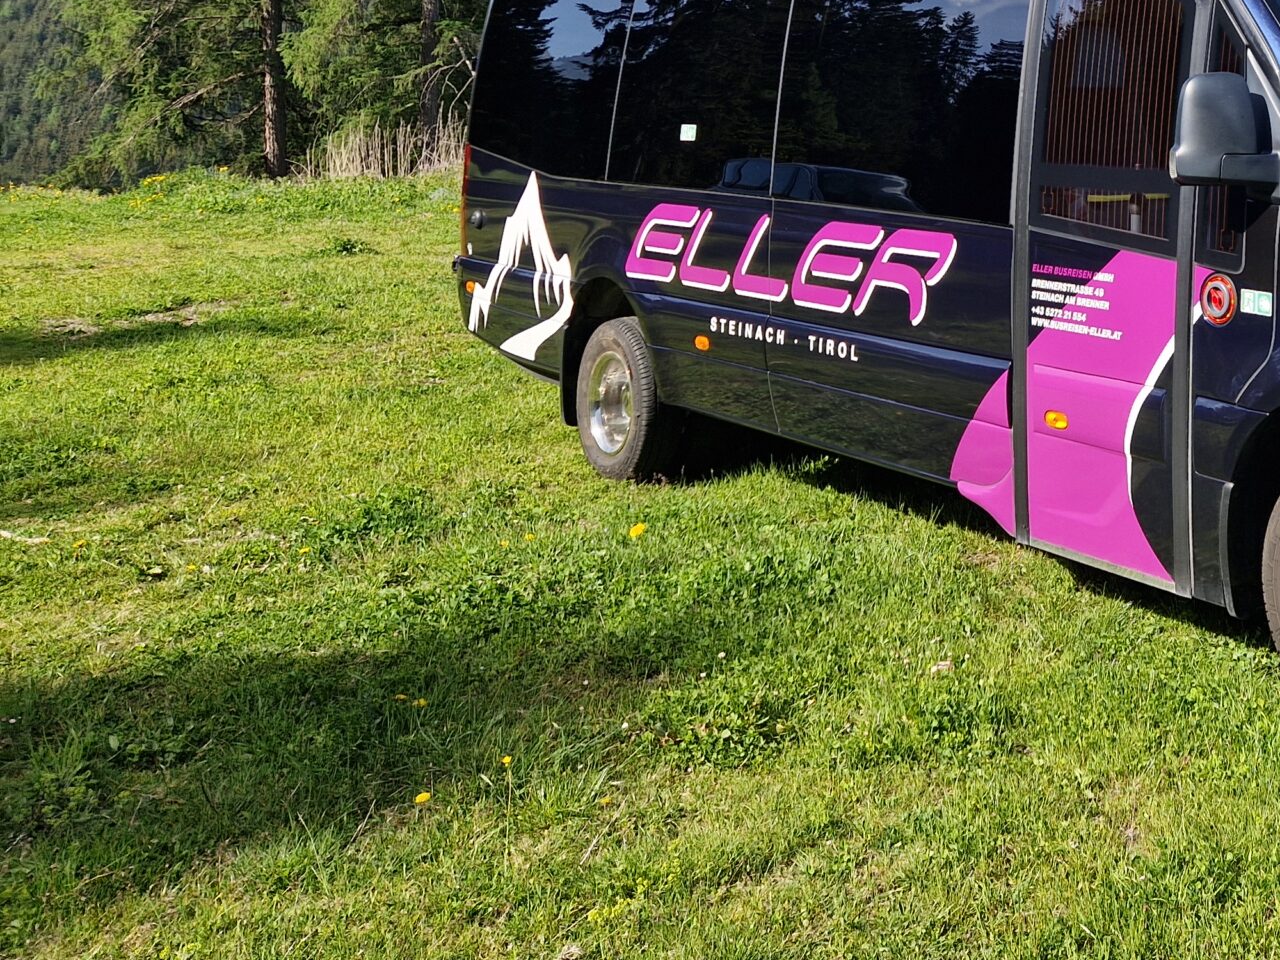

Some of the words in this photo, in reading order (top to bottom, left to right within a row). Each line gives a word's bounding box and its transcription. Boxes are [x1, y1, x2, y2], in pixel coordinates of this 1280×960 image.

[625, 202, 957, 326] ELLER
[1032, 263, 1053, 274] ELLER
[1053, 266, 1093, 279] BUSREISEN
[1093, 271, 1115, 283] GMBH
[1031, 290, 1064, 304] STEINACH
[1064, 295, 1076, 305] AM
[1076, 296, 1110, 311] BRENNER
[1031, 305, 1045, 316] +43
[1063, 310, 1072, 320] 21
[710, 316, 785, 346] STEINACH
[808, 335, 859, 362] TIROL
[1031, 316, 1122, 341] WWW.BUSREISEN-ELLER.AT
